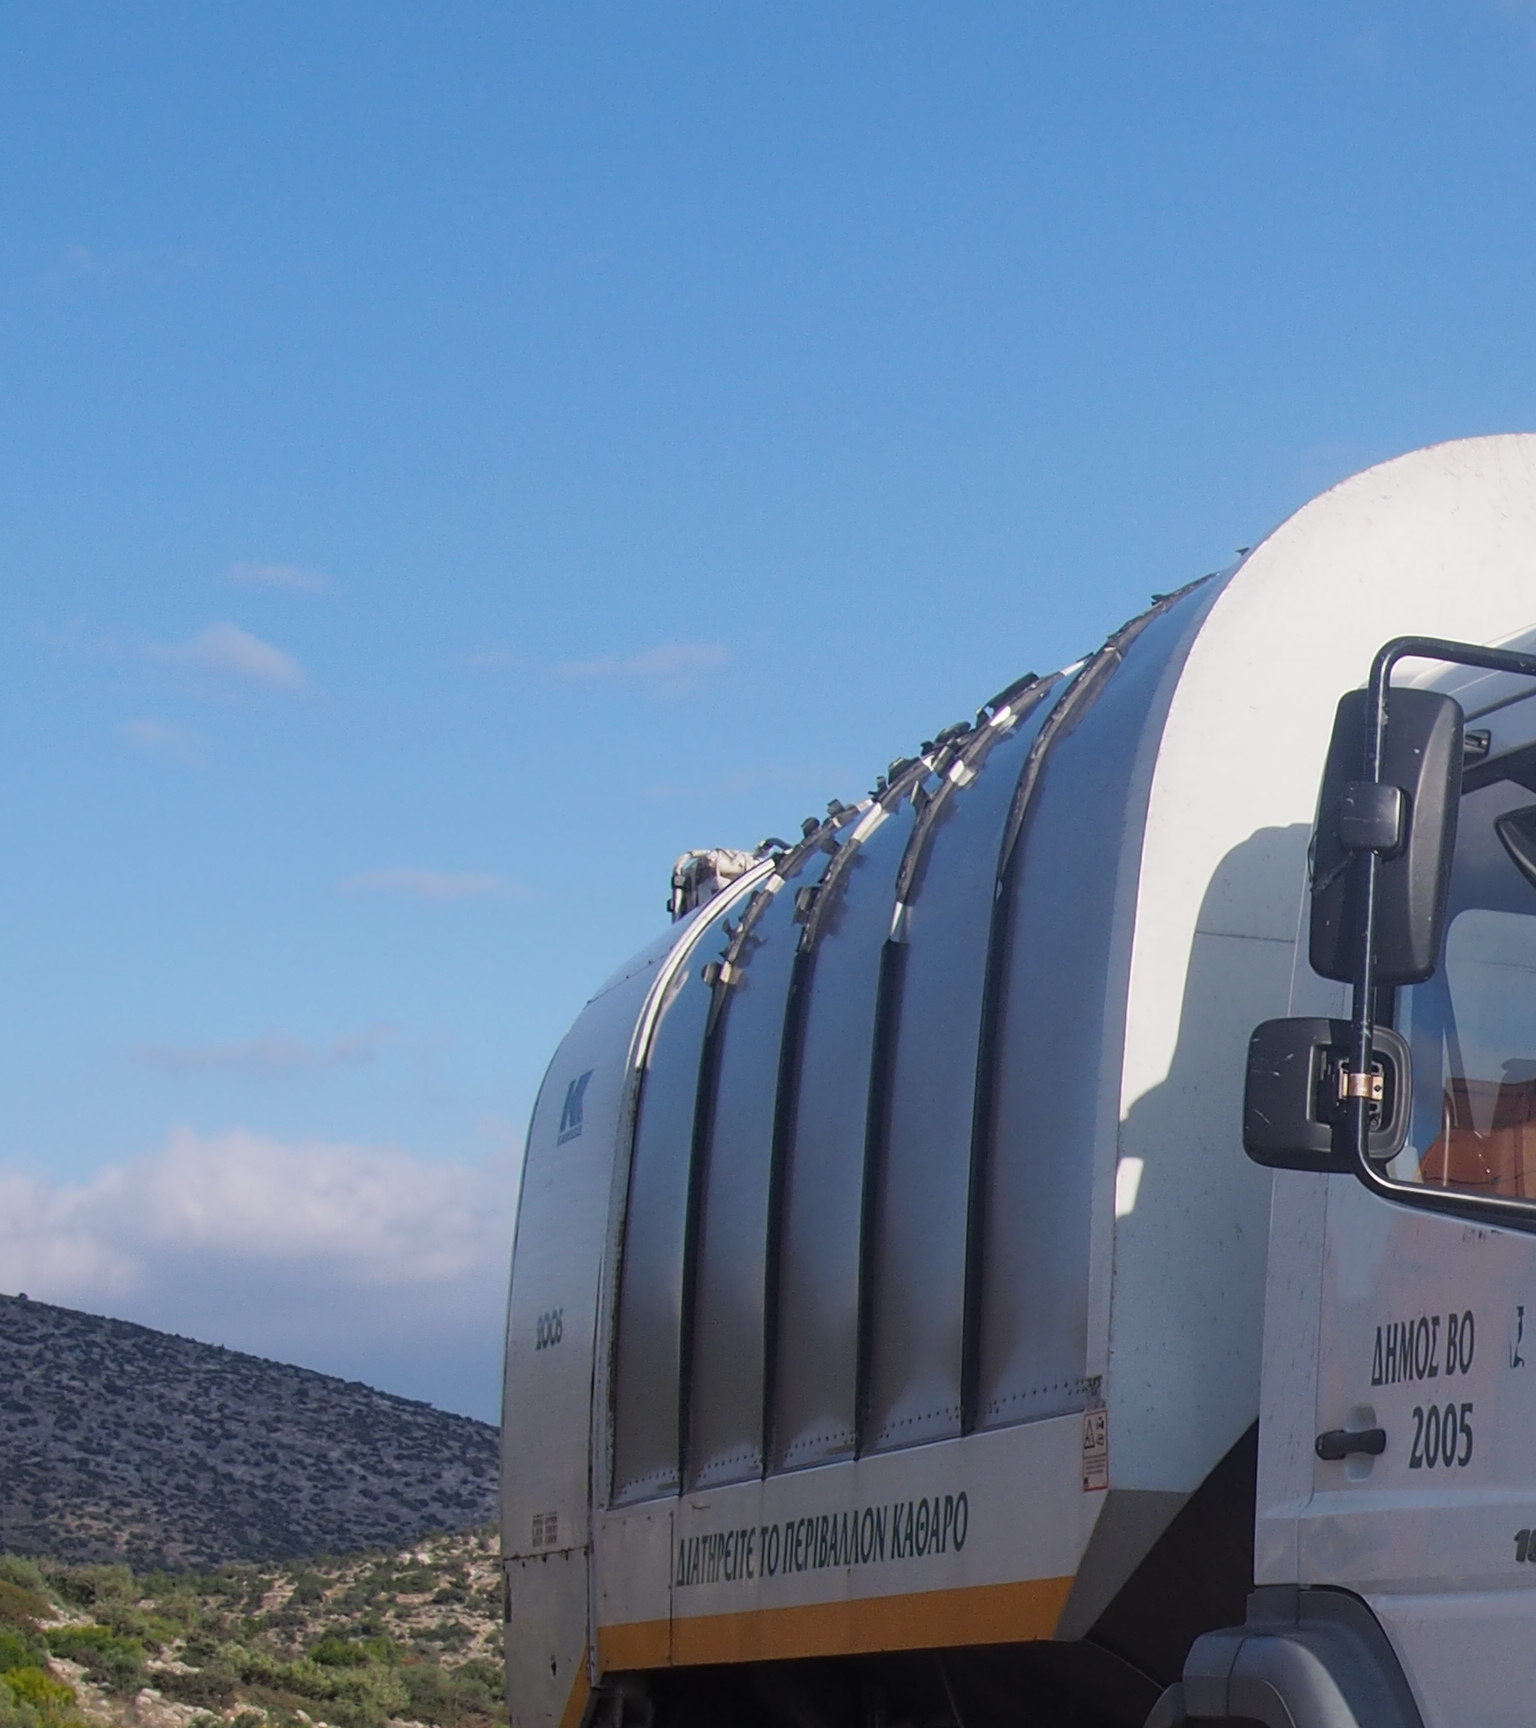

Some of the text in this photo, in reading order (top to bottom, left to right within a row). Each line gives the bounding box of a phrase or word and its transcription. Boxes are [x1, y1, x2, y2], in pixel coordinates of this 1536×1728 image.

[1371, 1316, 1440, 1386] ΔΗΜΟΣ
[1409, 1403, 1474, 1469] 2005
[676, 1491, 968, 1587] ΔΙΑΤΗΡΕΙΤΕ ΤΟ ΠΕΡΙΒΑΛΛΟΝ ΚΑΘΑΡΟ
